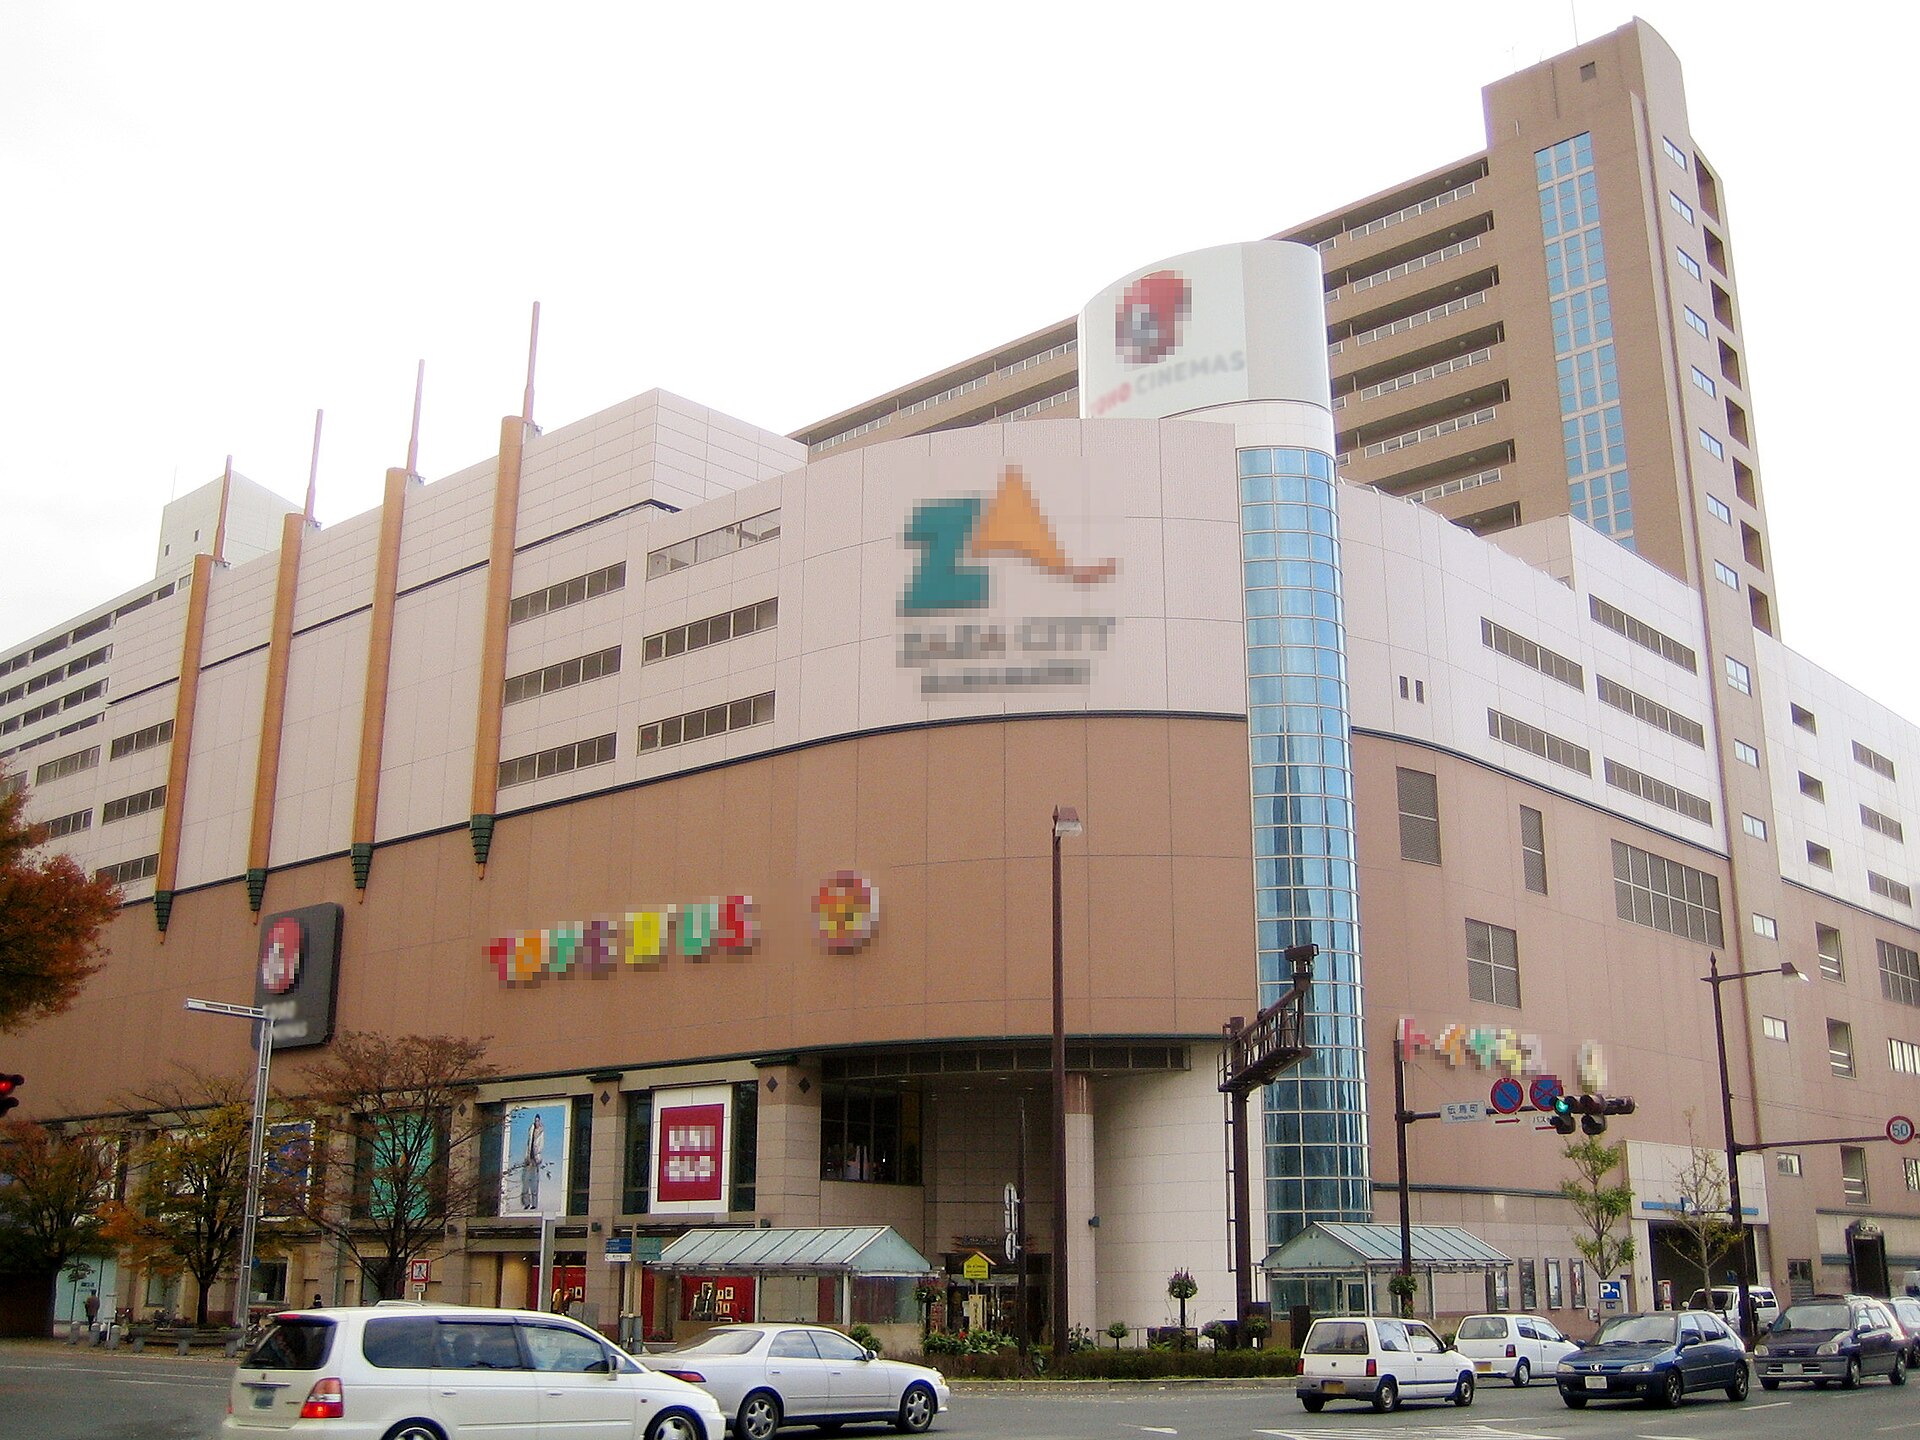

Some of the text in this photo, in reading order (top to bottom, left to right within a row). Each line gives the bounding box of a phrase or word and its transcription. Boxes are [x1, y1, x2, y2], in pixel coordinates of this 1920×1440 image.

[1135, 351, 1245, 395] CINEMAS
[1892, 1123, 1909, 1137] 50
[1600, 1283, 1611, 1298] P
